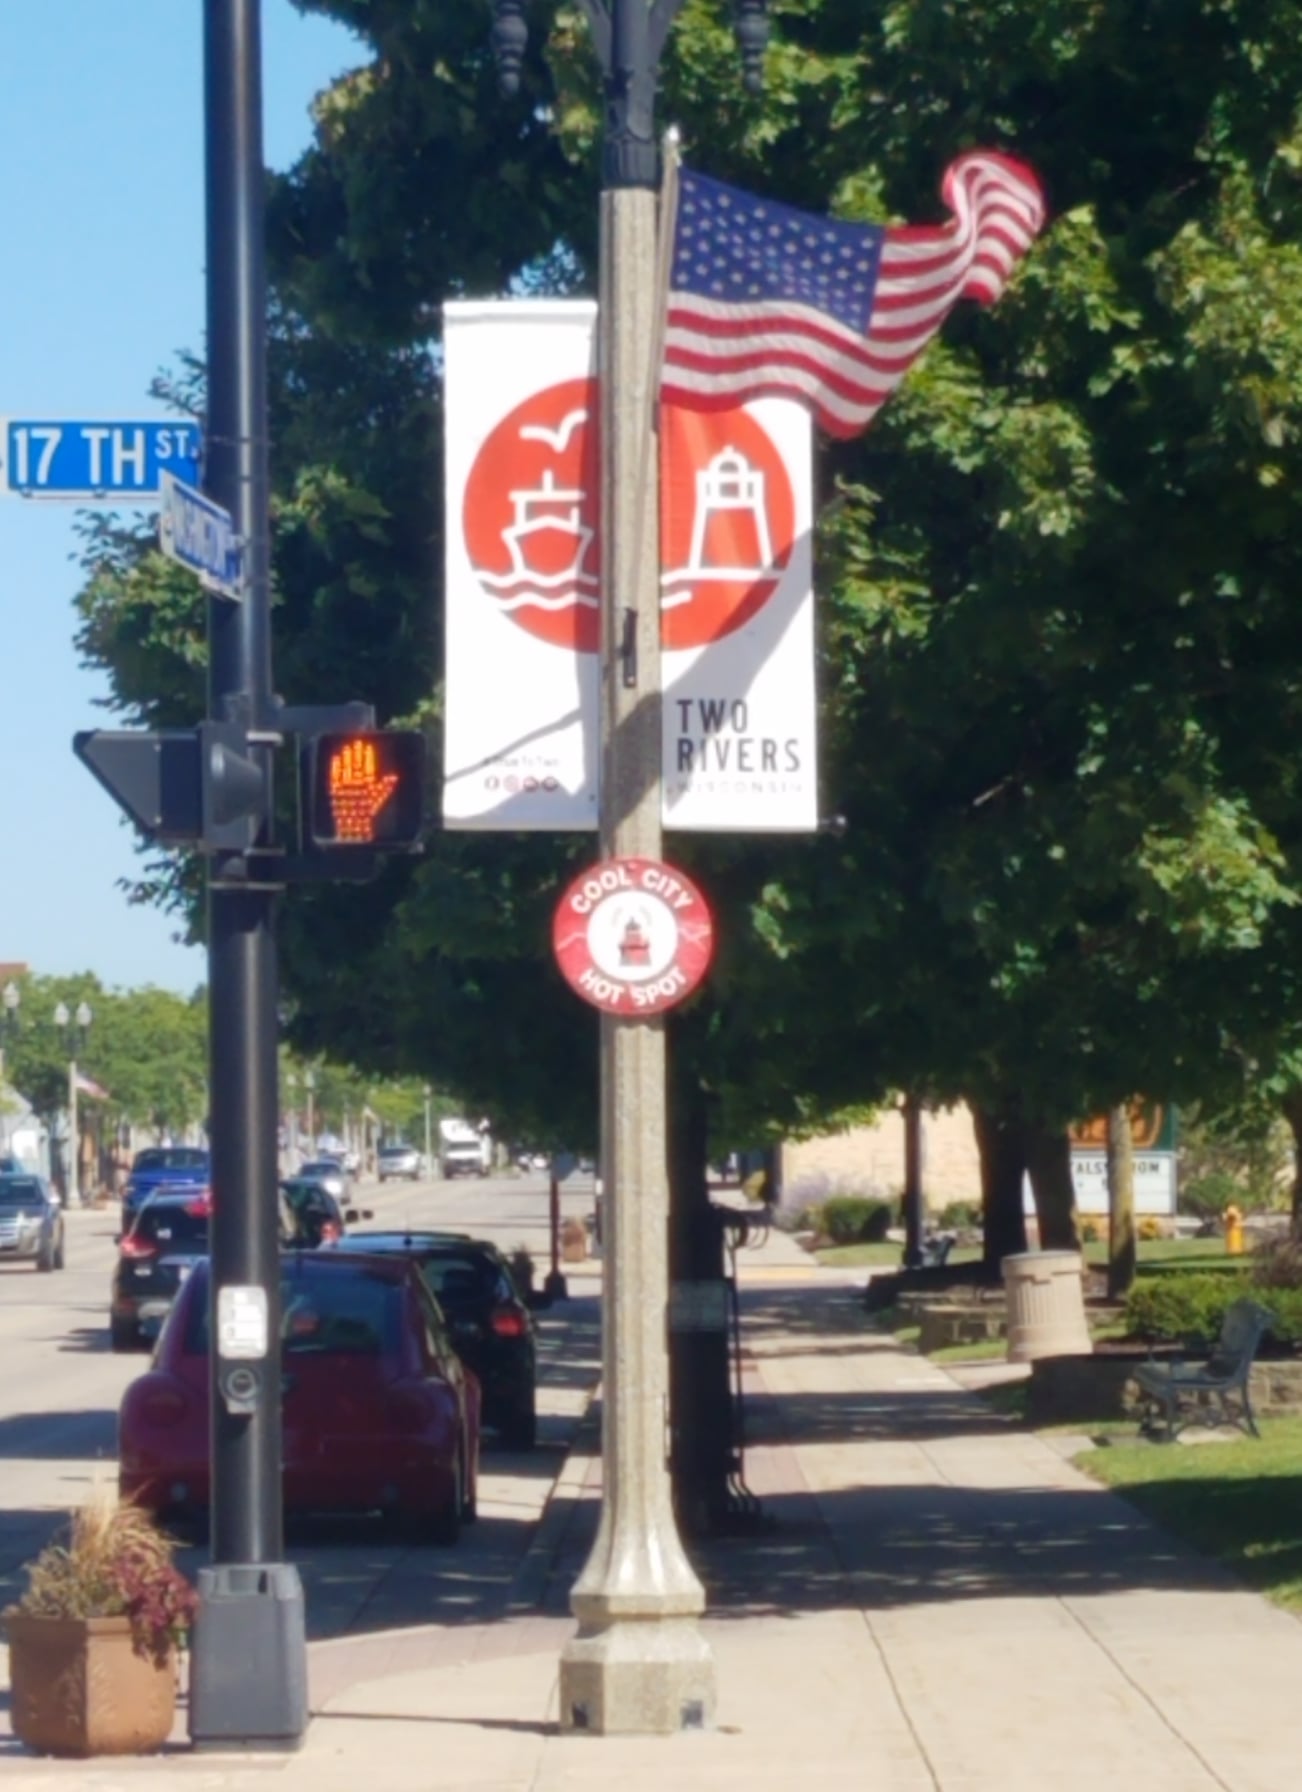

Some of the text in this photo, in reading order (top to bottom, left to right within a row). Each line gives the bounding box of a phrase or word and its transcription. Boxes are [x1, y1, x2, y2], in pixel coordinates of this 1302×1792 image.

[13, 428, 62, 485] 17
[80, 428, 145, 485] TH
[676, 698, 748, 734] TWO
[677, 737, 801, 773] RIVERS
[570, 865, 694, 914] COOL CITY
[579, 965, 687, 1007] HOT SPOT
